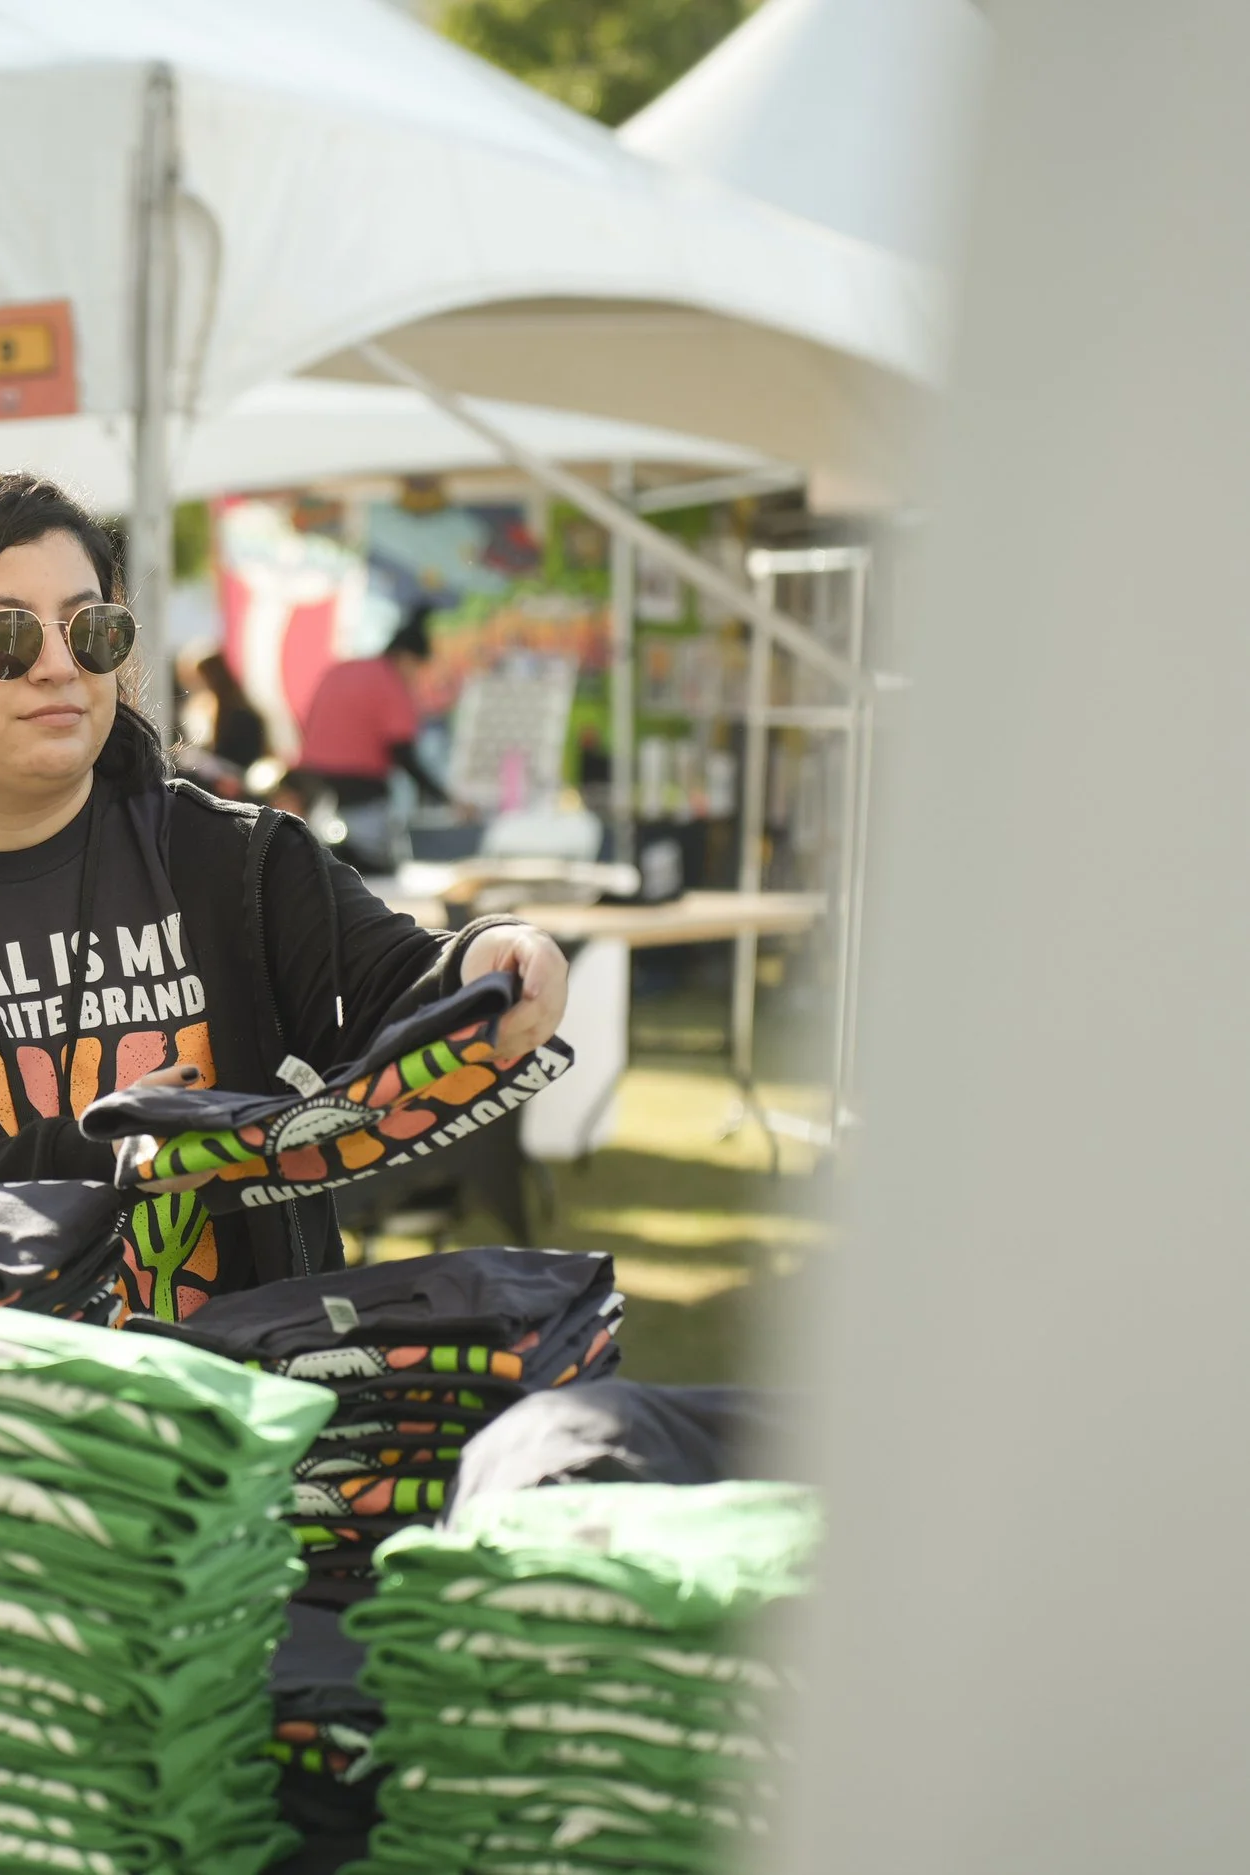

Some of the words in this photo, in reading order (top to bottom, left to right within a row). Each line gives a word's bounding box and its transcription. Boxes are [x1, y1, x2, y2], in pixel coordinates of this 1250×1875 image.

[49, 930, 104, 986] IS
[116, 912, 186, 977] MY
[80, 974, 206, 1030] BRAND
